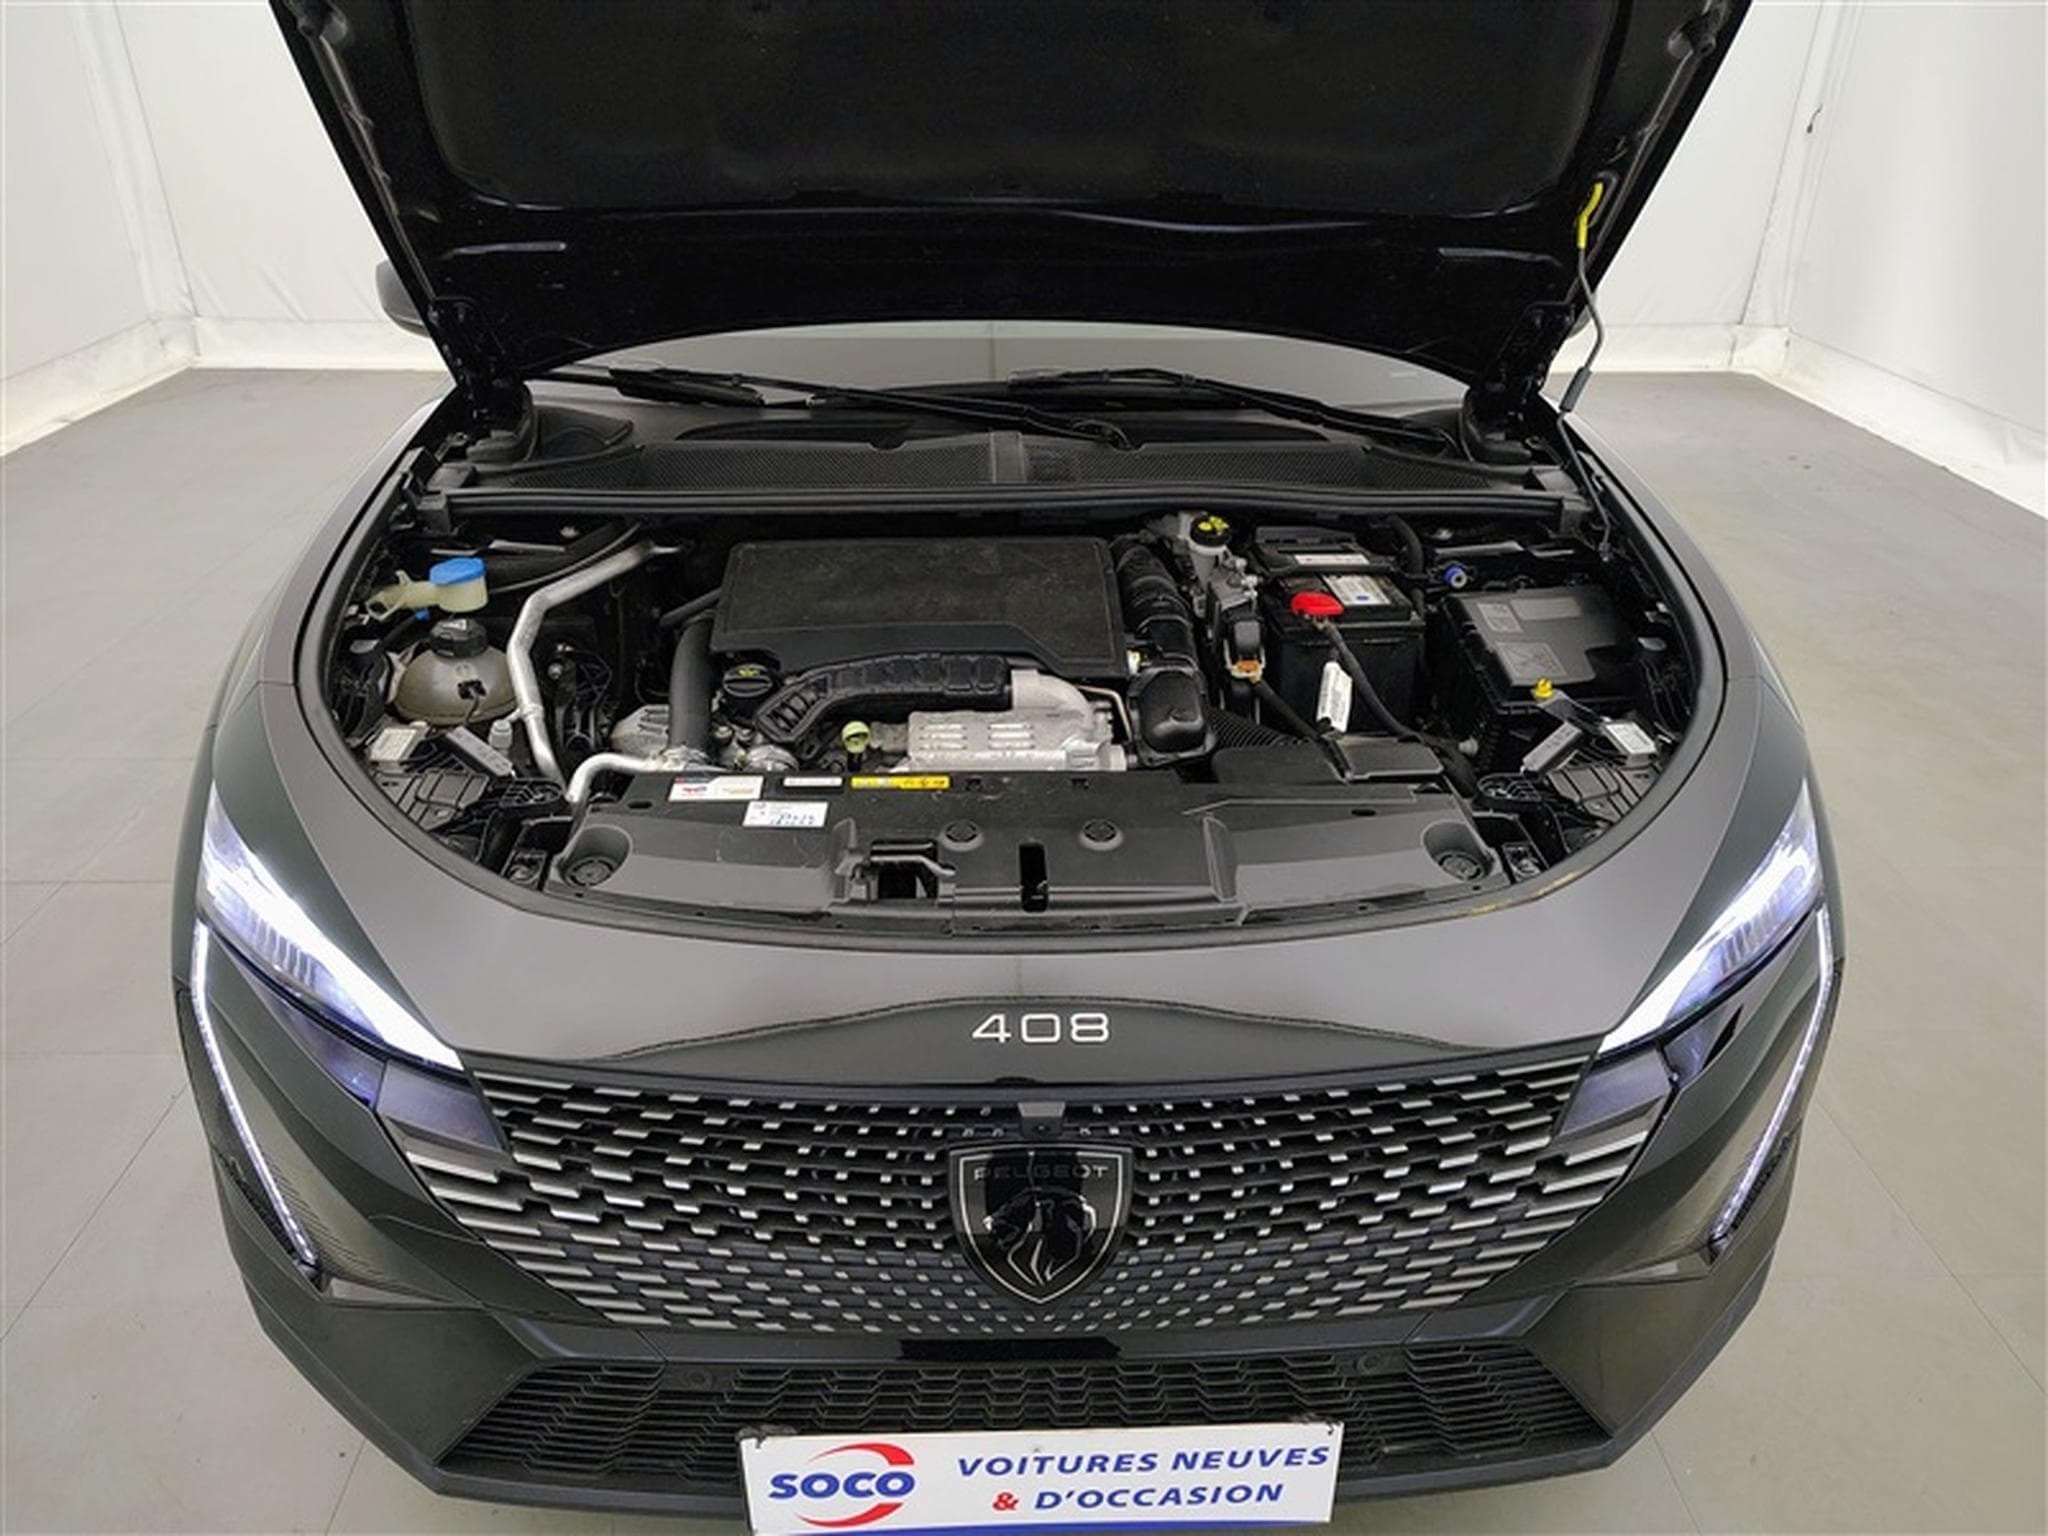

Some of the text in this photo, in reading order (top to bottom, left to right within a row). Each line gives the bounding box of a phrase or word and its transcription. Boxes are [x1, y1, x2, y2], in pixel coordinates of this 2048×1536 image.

[972, 1012, 1109, 1043] 408
[958, 1446, 1329, 1477] VOITURES NEUVES
[768, 1471, 915, 1499] SOCO
[992, 1482, 1283, 1511] & D'OCCASION
